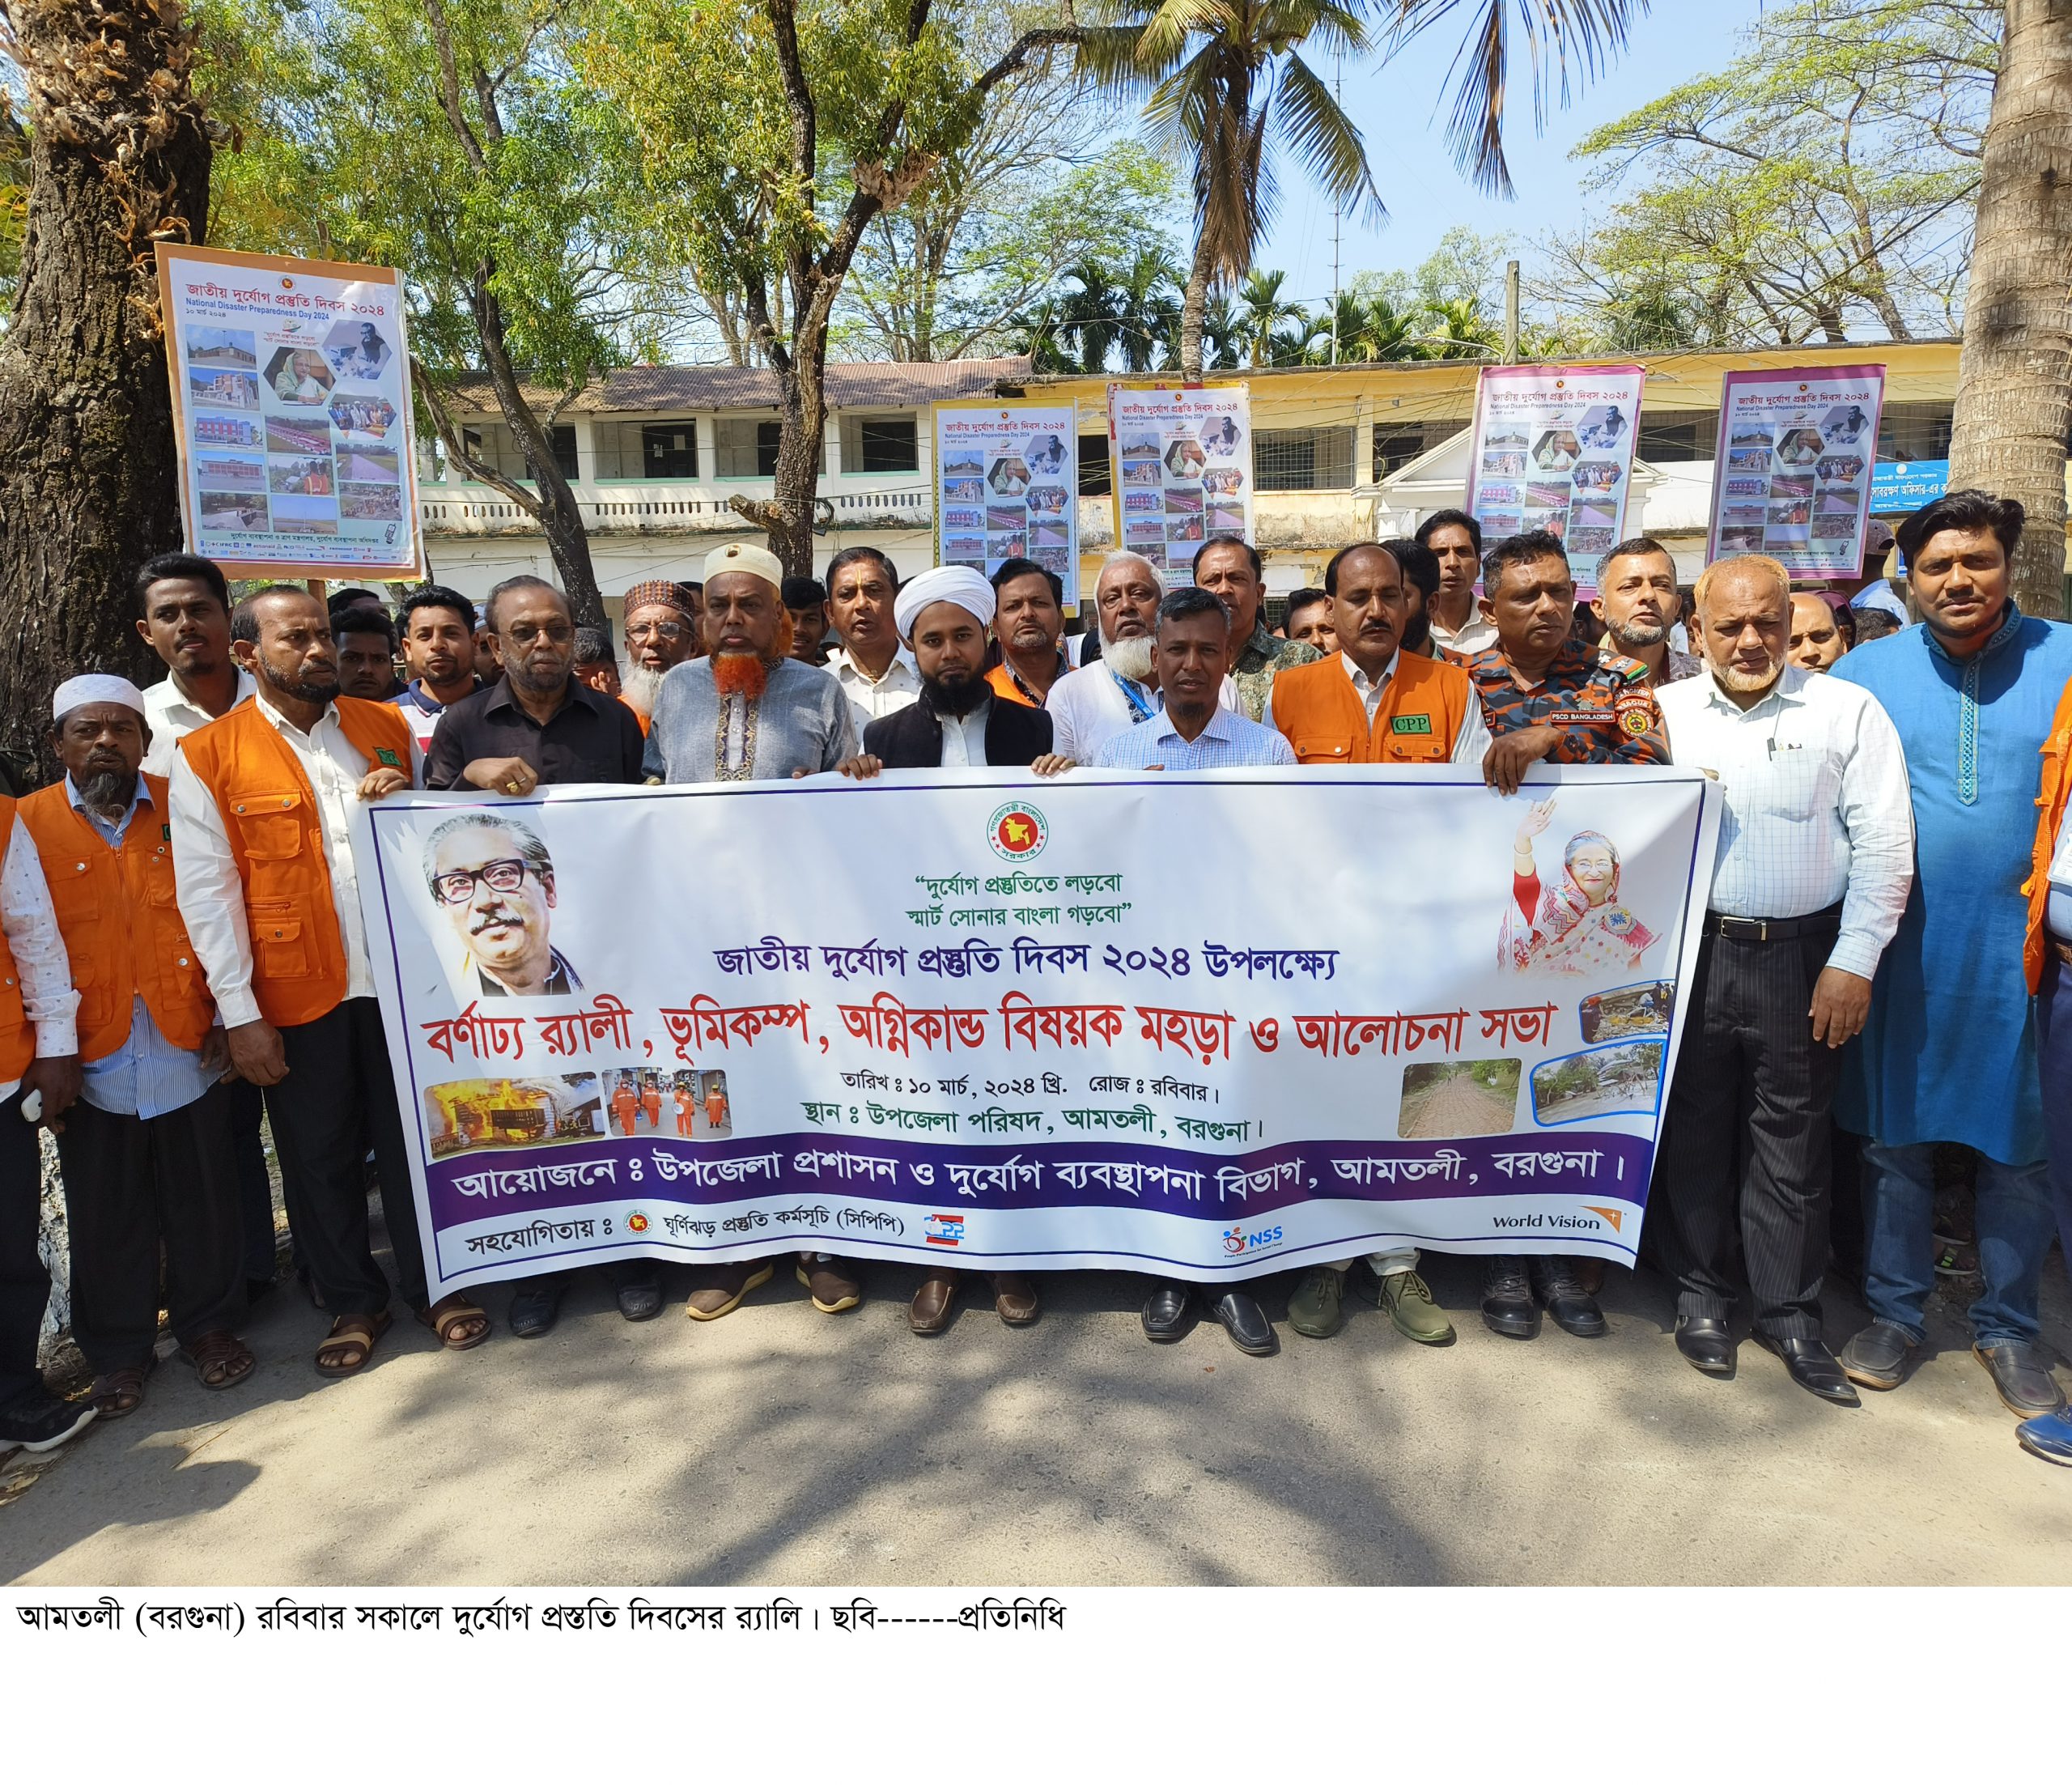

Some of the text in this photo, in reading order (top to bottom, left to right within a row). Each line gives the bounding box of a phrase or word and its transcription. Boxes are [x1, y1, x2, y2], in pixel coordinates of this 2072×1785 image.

[185, 282, 384, 316] জাতীয় দুর্যোগ প্রস্তুতি দিবস ২০২৪
[186, 297, 329, 320] National Disaster Preparedness Day 2024
[1492, 392, 1518, 402] জাতীয়
[1522, 391, 1547, 402] দুর্যোগ
[1577, 390, 1599, 401] দিবস
[1603, 391, 1628, 401] ২০২৪
[1738, 394, 1763, 405] জাতীয়
[1766, 394, 1790, 406] দুর্যোগ
[1820, 393, 1841, 402] দিবস
[1844, 393, 1869, 401] ২০২৪
[1122, 403, 1144, 414] জাতীয়
[1148, 403, 1169, 414] দুর্যোগ
[1194, 402, 1213, 412] দিবস
[1216, 403, 1238, 412] ২০২৪
[945, 421, 970, 431] জাতীয়
[972, 420, 995, 432] দুর্যোগ
[1021, 420, 1040, 430] দিবস
[1042, 422, 1065, 431] ২০২৪
[1395, 718, 1426, 730] CPP
[985, 871, 1059, 895] প্রস্তুতিতে
[1064, 873, 1123, 895] লড়বো
[905, 904, 944, 927] স্মার্ট
[949, 907, 1008, 926] সোনার
[1013, 906, 1061, 925] বাংলা
[712, 936, 1340, 981] জাতীয় দুর্যোগ প্রস্তুতি দিবস ২০২৪ উপলক্ষ্যে
[420, 1001, 525, 1063] বর্ণাঢ্য
[997, 991, 1126, 1052] বিষয়ক
[1134, 1006, 1237, 1065] মহড়া
[1249, 1018, 1278, 1052] ও
[1292, 1007, 1471, 1057] আলোচনা
[1479, 1001, 1559, 1048] সভা
[909, 1078, 931, 1094] ১০
[985, 1078, 1034, 1098] ২০২৪
[866, 1100, 960, 1133] উপজেলা
[651, 1148, 783, 1186] উপজেলা
[794, 1149, 899, 1184] প্রশাসন
[909, 1164, 934, 1185] ও
[944, 1154, 1045, 1198] দুর্যোগ
[1052, 1161, 1206, 1201] ব্যবস্থাপনা
[663, 1214, 716, 1238] ঘূর্ণিঝড়
[722, 1211, 769, 1232] প্রস্তুতি
[773, 1205, 830, 1228] কর্মসূচি
[837, 1209, 904, 1236] (সিপিপি)
[1493, 1214, 1600, 1229] World Vision
[1250, 1226, 1282, 1247] NSS
